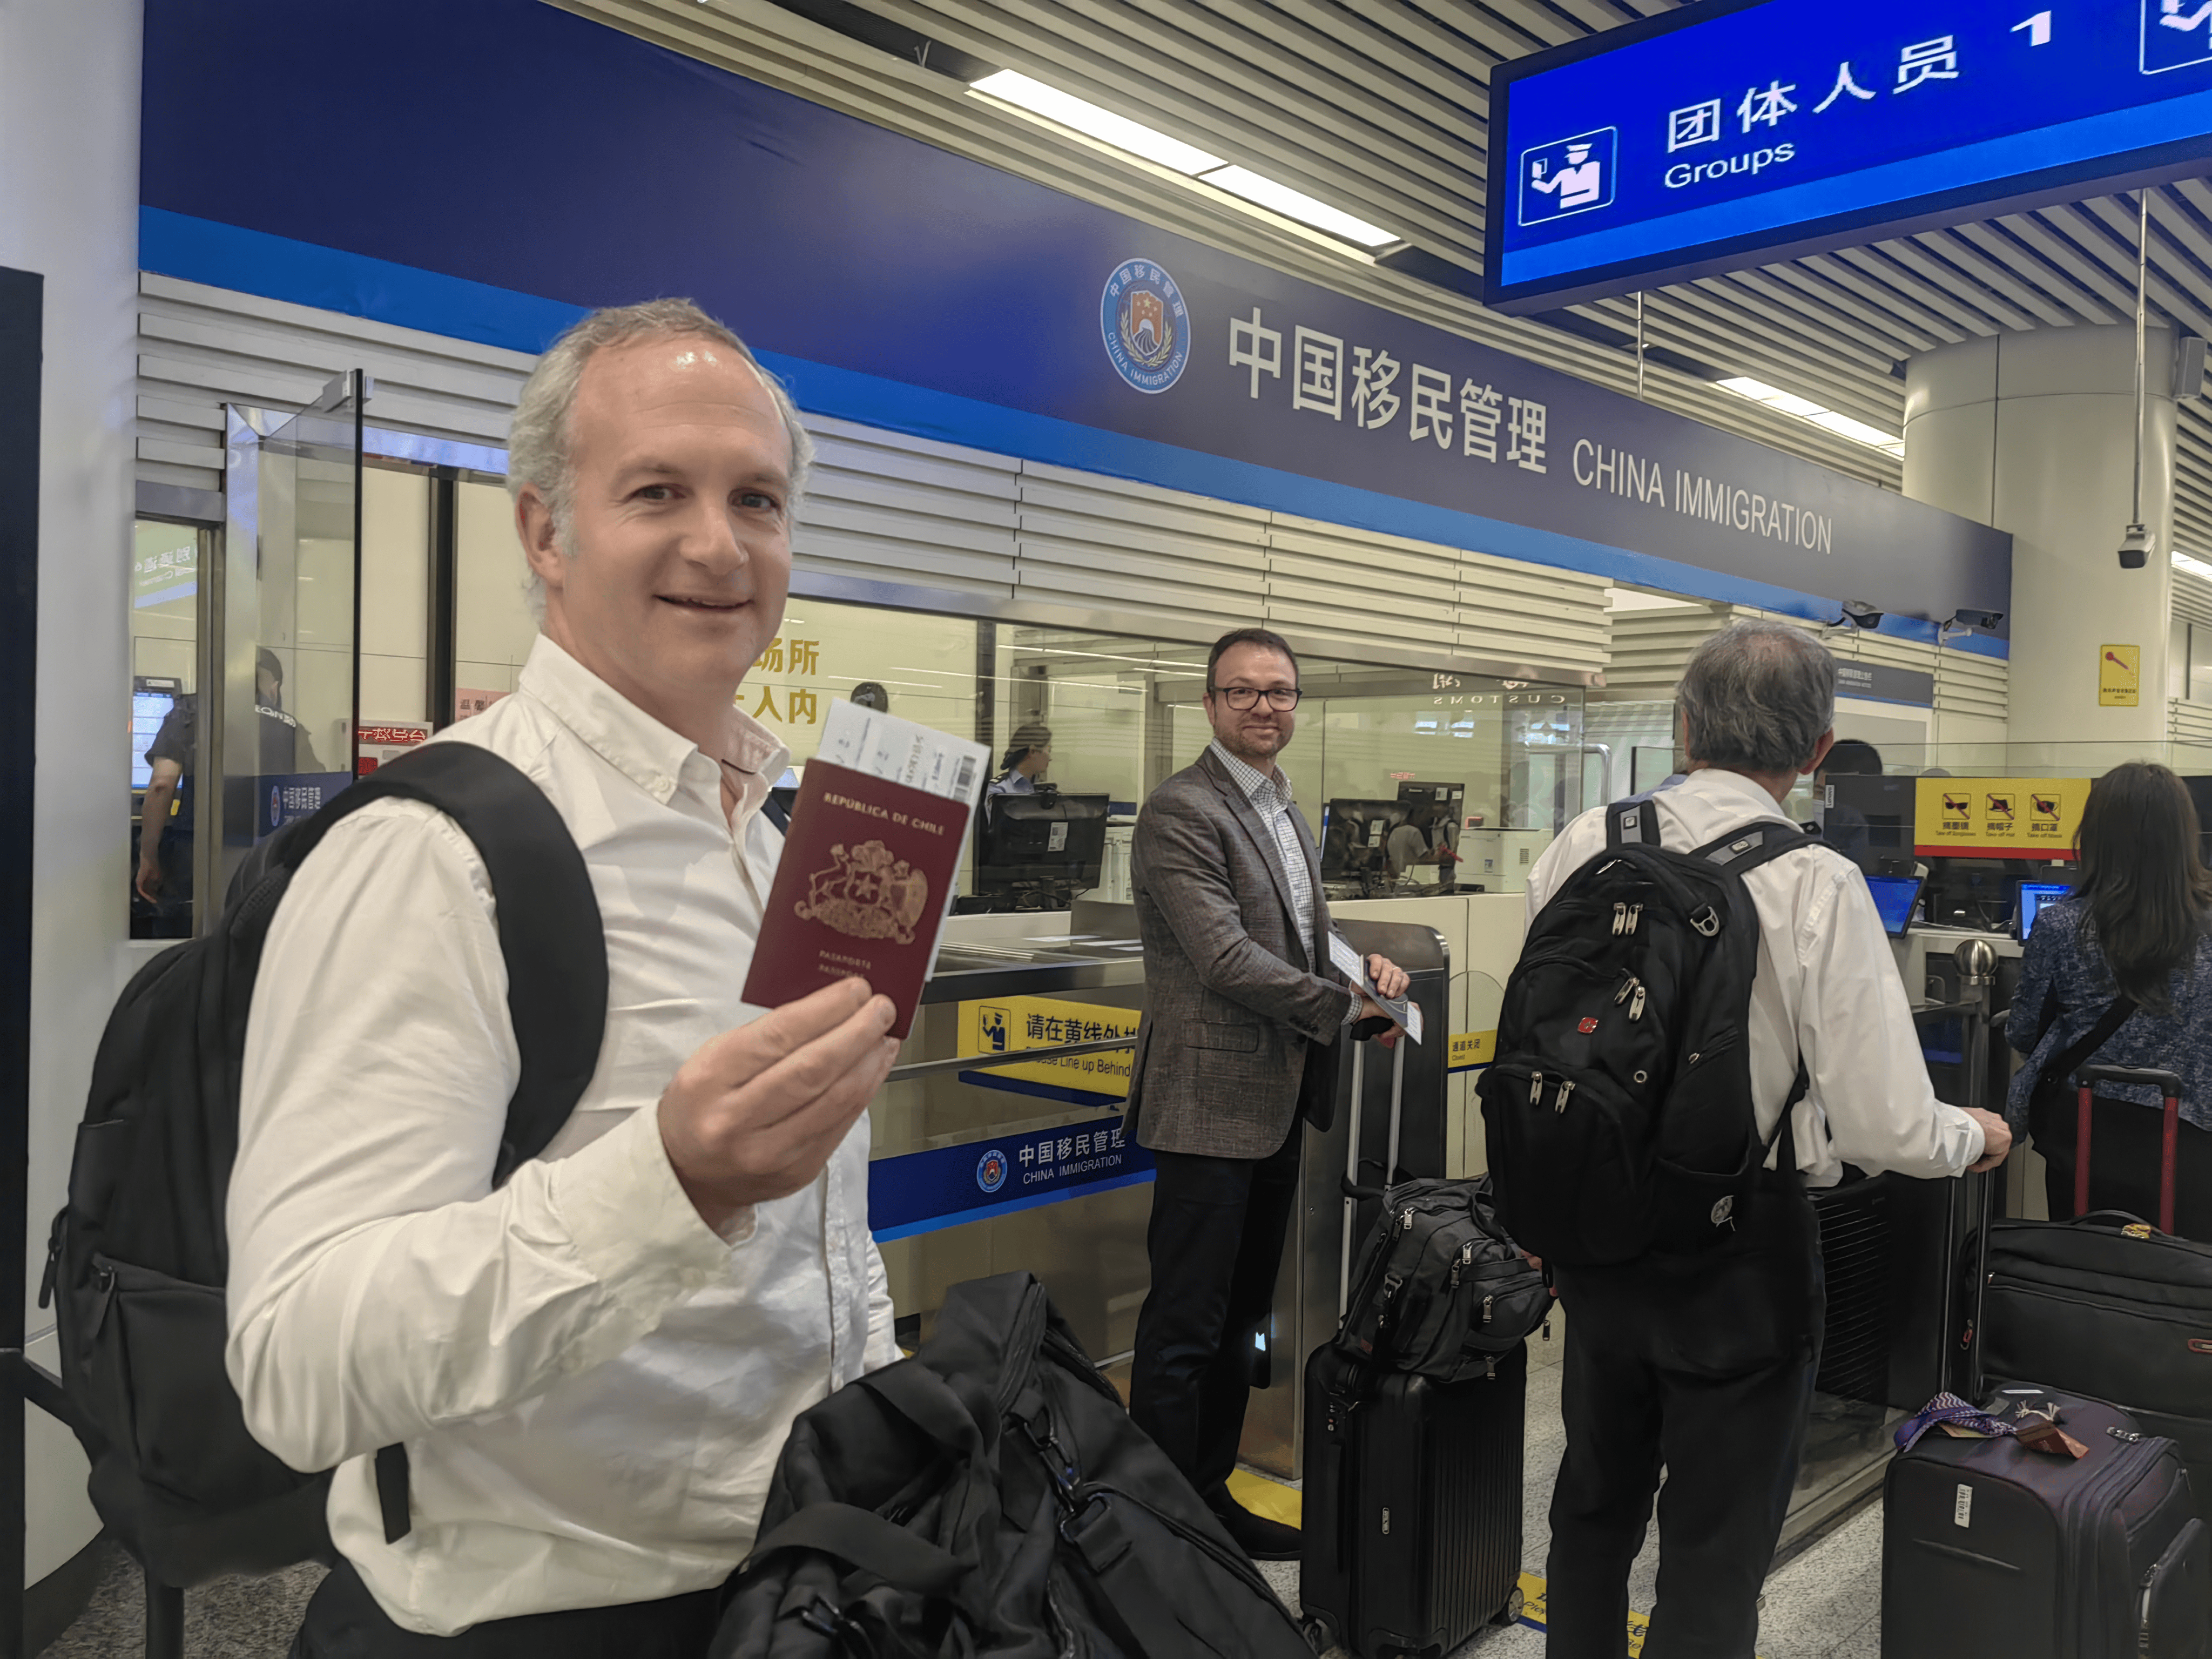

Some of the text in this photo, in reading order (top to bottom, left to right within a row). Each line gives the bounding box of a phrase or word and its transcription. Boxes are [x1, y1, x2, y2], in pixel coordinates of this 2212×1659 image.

[1667, 9, 2052, 153] 团体人员 1
[1664, 143, 1795, 188] Groups
[1228, 307, 1548, 474] 中国移民管理
[1573, 438, 1832, 555] CHINA IMMIGRATION
[735, 686, 817, 725] 人内
[892, 812, 909, 826] DE
[912, 818, 945, 836] CHILE
[819, 950, 871, 970] PASAPORTE
[1060, 1056, 1080, 1069] Line
[1082, 1060, 1094, 1075] up
[1097, 1058, 1131, 1077] Behind
[1019, 1126, 1125, 1168] 中国移民管理
[1023, 1168, 1054, 1184] CHINA
[1059, 1154, 1122, 1177] IMMIGRATION
